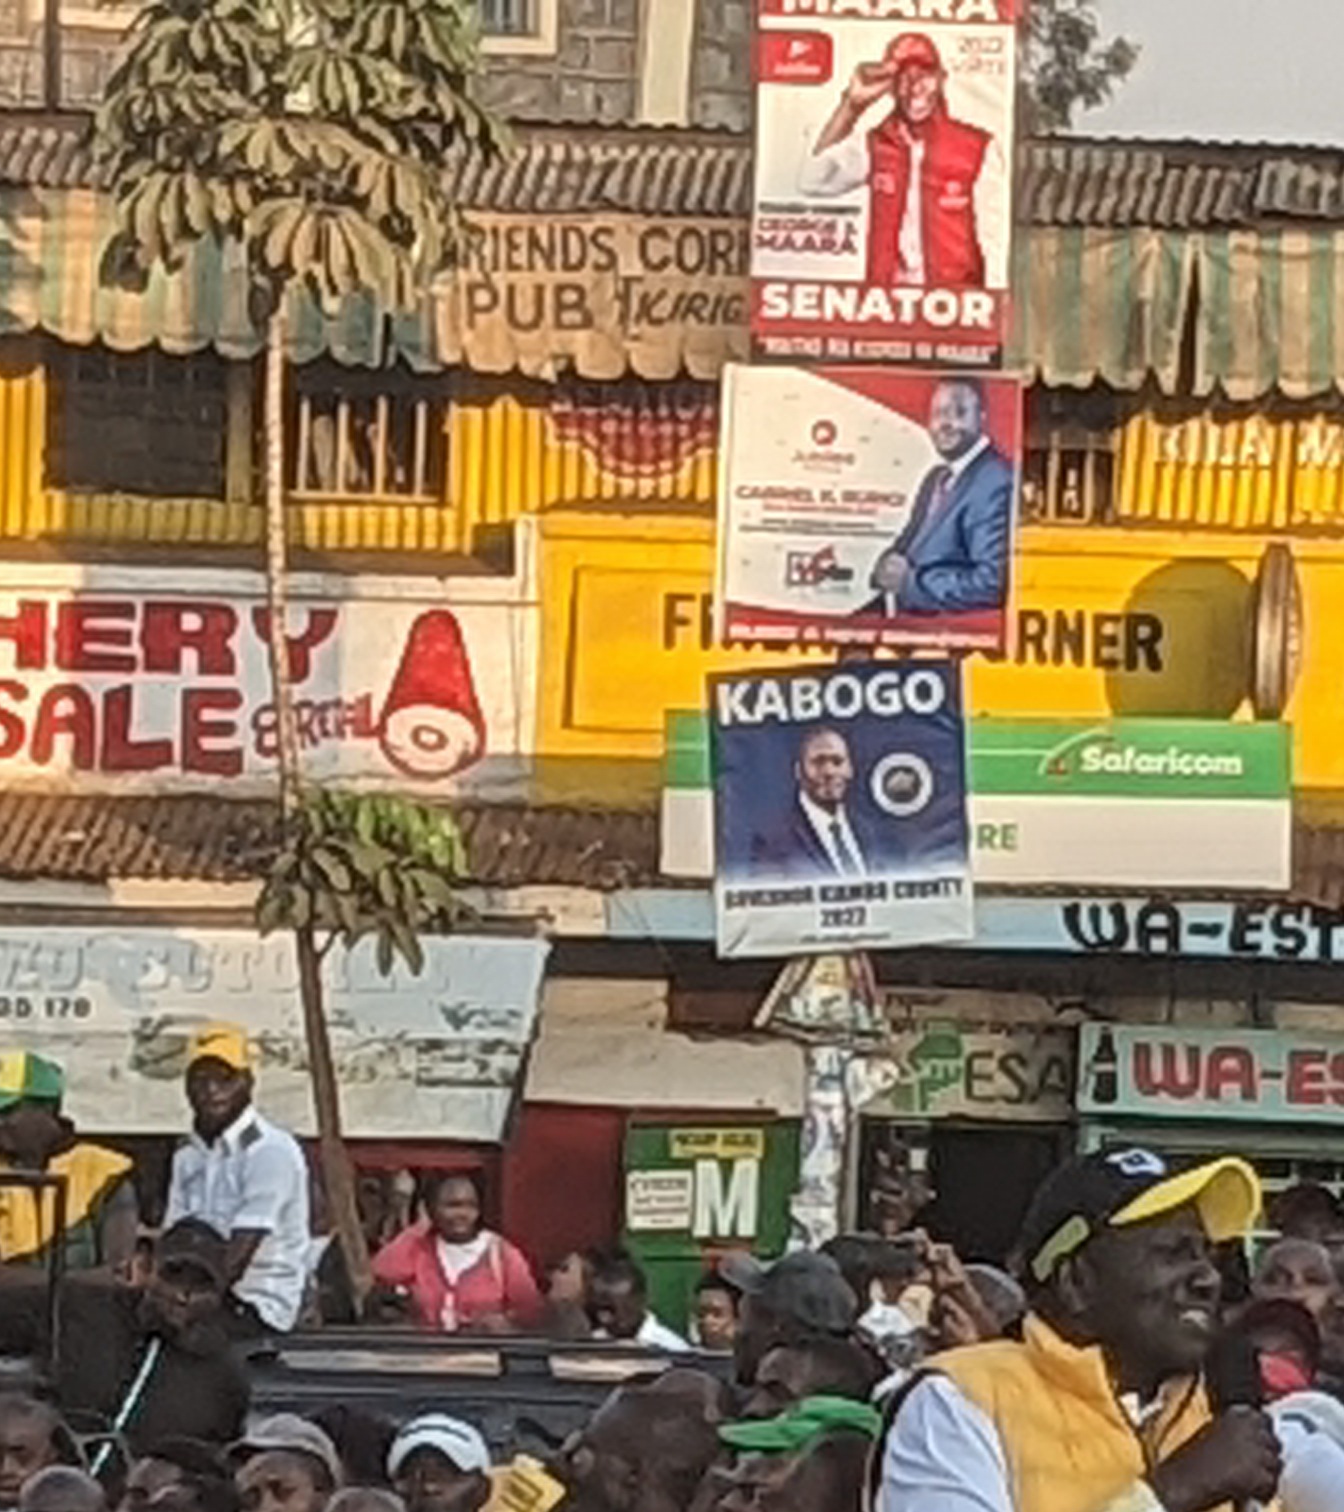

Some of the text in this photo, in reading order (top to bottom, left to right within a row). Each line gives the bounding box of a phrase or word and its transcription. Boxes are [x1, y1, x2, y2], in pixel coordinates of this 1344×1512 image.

[462, 224, 618, 273] RIENDS
[467, 281, 594, 332] PUB
[761, 283, 995, 328] SENATOR
[1017, 608, 1164, 673] RNER
[715, 670, 946, 727] KABOGO
[1080, 745, 1244, 778] Safaricom
[977, 823, 1019, 851] RE
[893, 877, 964, 900] COUNTY
